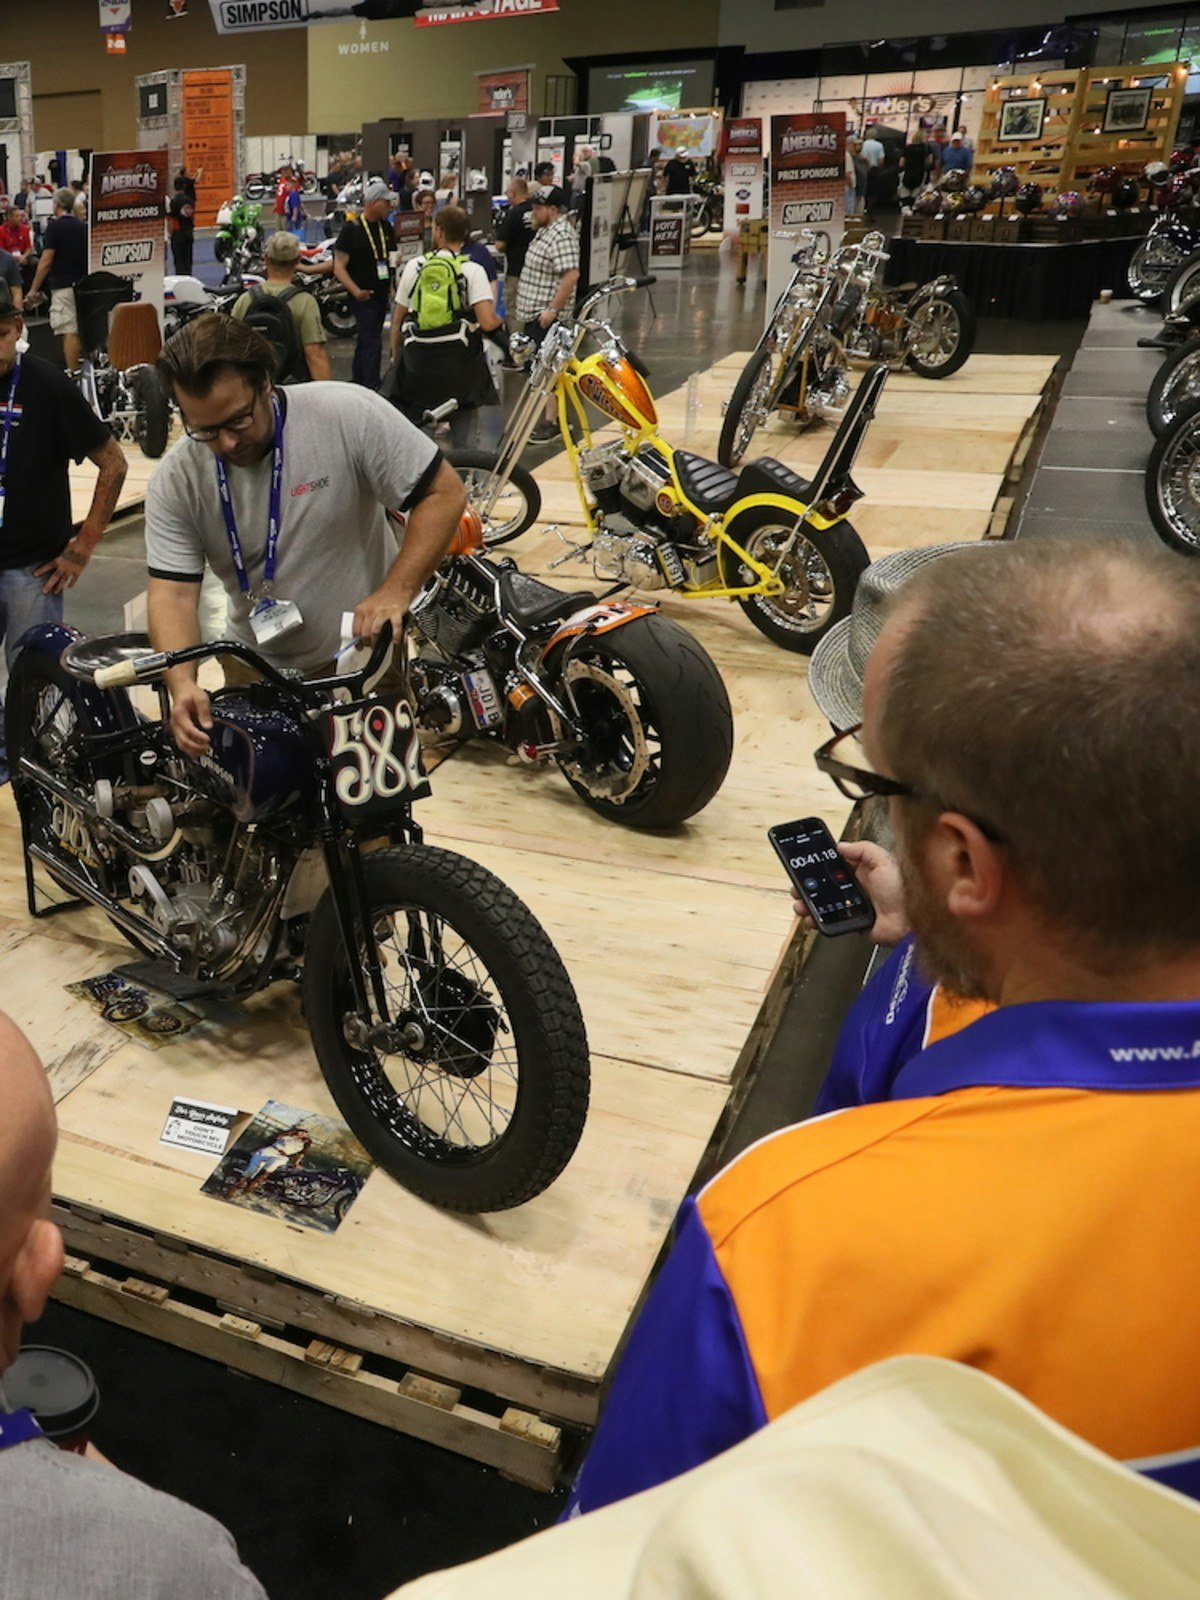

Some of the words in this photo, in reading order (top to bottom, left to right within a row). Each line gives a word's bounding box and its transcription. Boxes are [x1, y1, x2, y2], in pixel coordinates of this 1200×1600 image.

[227, 0, 301, 24] SIMPSON
[338, 41, 390, 55] WOMEN
[781, 133, 837, 151] AMERICAS
[778, 170, 799, 181] PRIZE
[800, 167, 839, 179] SPONSORS
[101, 172, 158, 194] AMERICAS
[97, 210, 118, 221] PRIZE
[120, 206, 159, 220] SPONSORS
[784, 202, 832, 224] SIMPSON
[655, 220, 677, 231] VOTE
[654, 231, 678, 242] HERE
[103, 242, 152, 265] SIMPSON
[291, 476, 330, 497] LIGHTSHOE
[332, 699, 429, 806] 582
[790, 848, 838, 869] 00:41.18
[185, 1129, 207, 1139] TOUCH
[193, 1125, 215, 1134] DON'T
[177, 1134, 224, 1150] MOTORCYCLE
